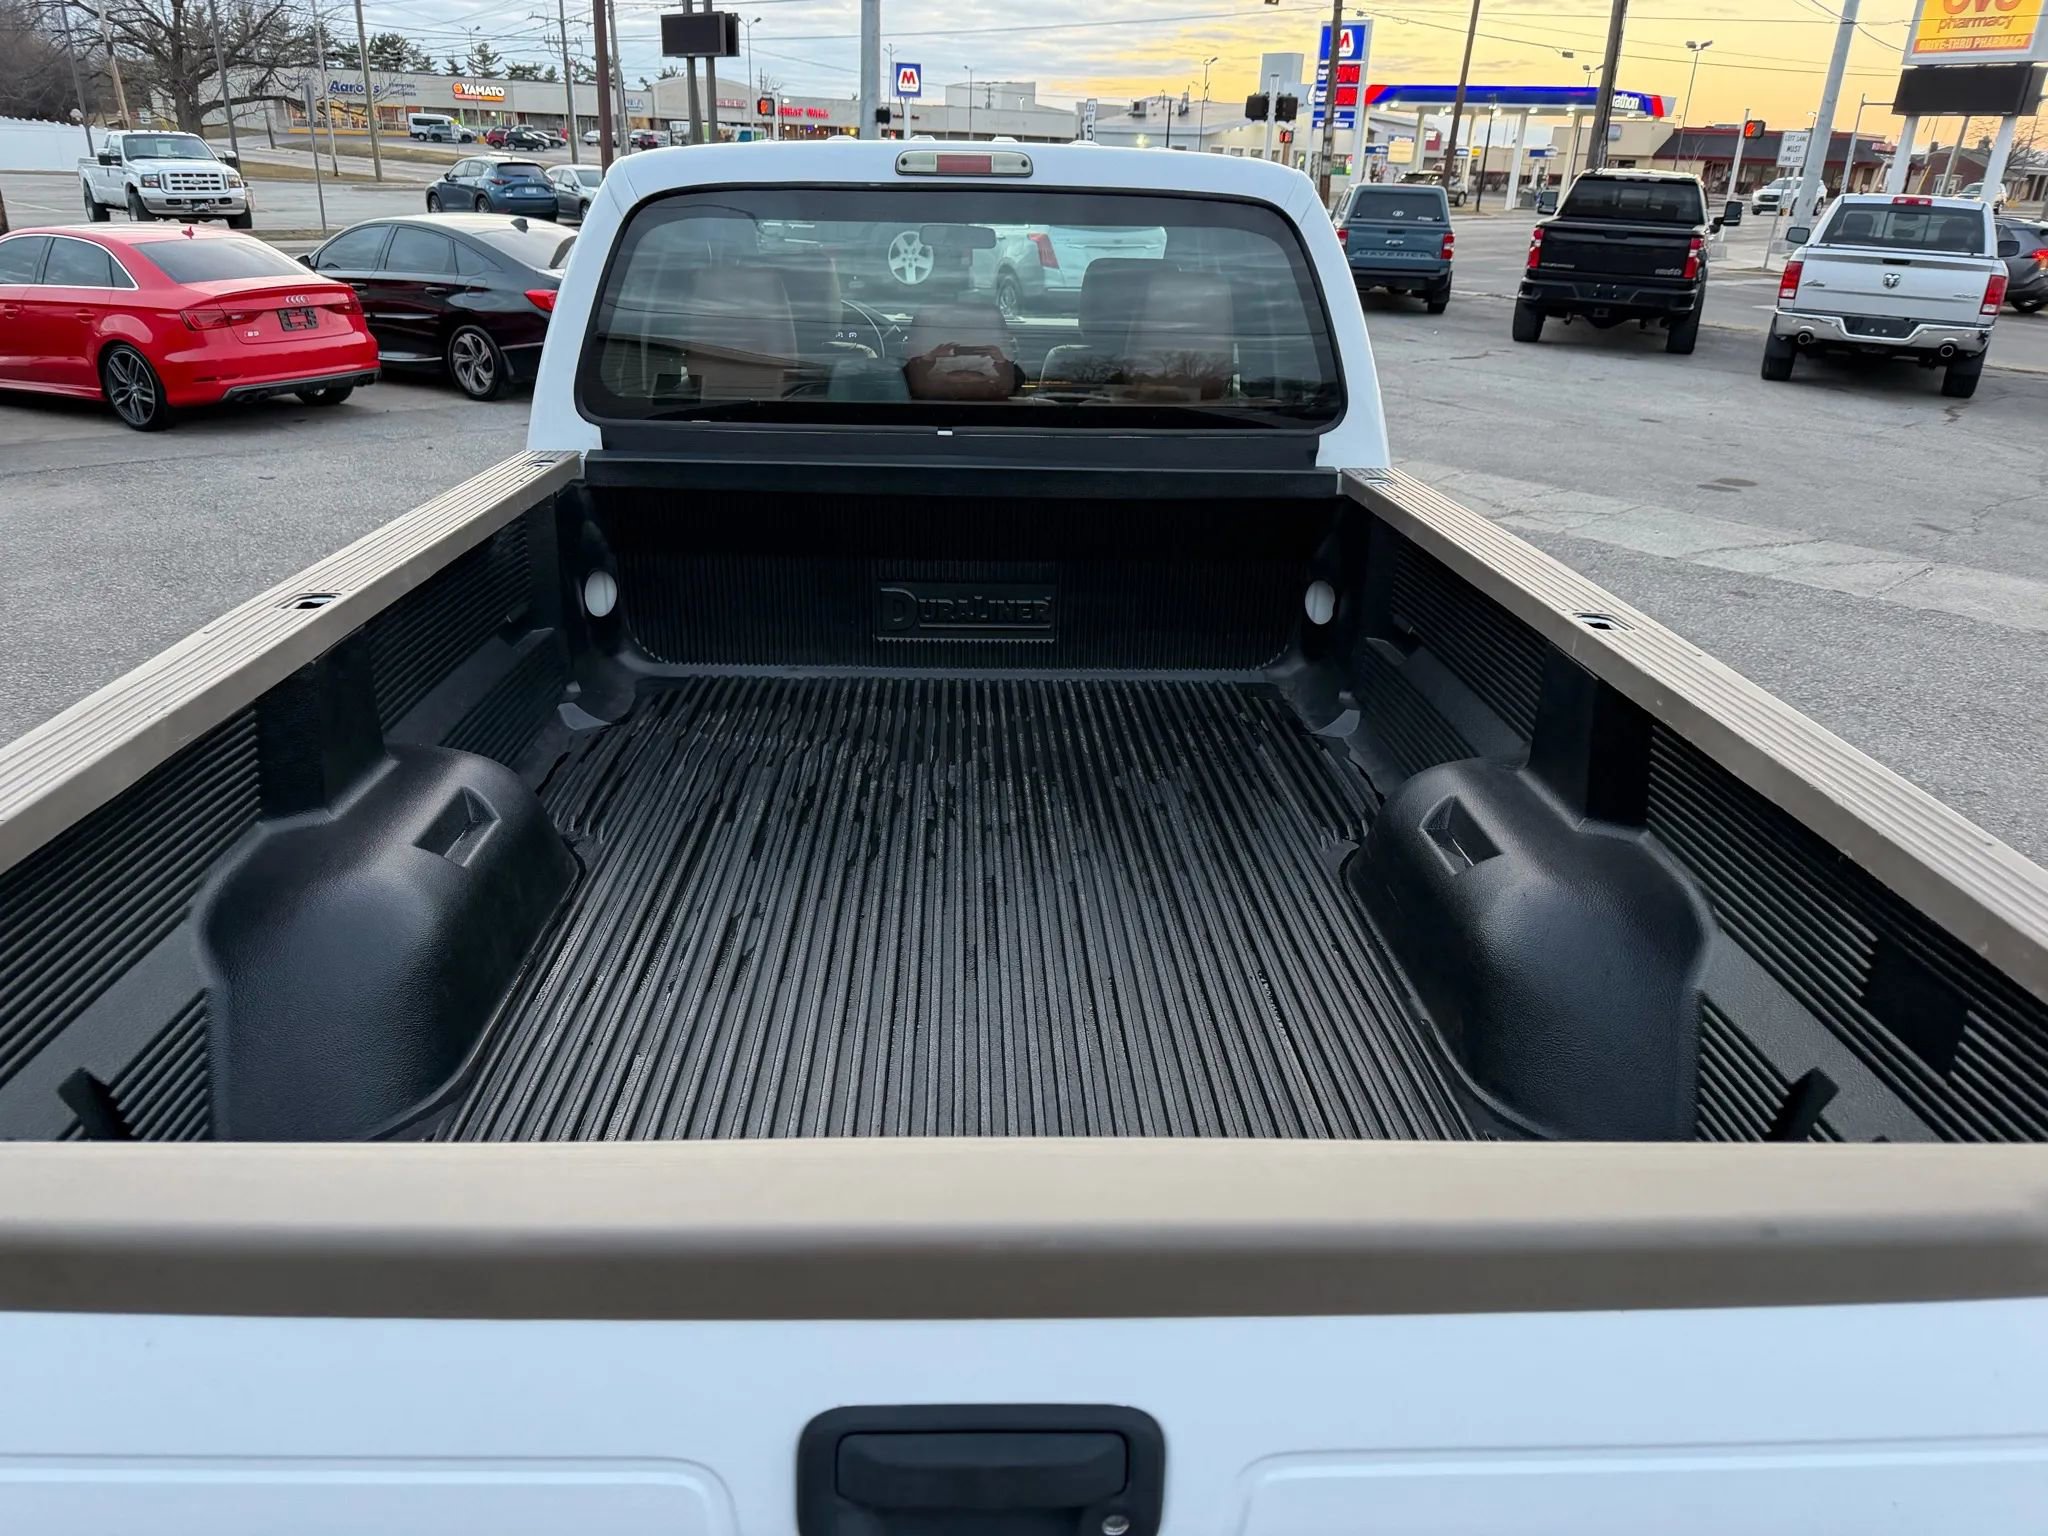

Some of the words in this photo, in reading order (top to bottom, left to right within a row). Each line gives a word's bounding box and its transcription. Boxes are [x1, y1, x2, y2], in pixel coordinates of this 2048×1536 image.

[1937, 16, 2015, 33] pharmacy
[1919, 36, 1973, 50] DRIVE-THRU
[1975, 33, 2027, 48] PHARMACY
[462, 83, 505, 97] YAMATO
[1611, 93, 1640, 110] rathon
